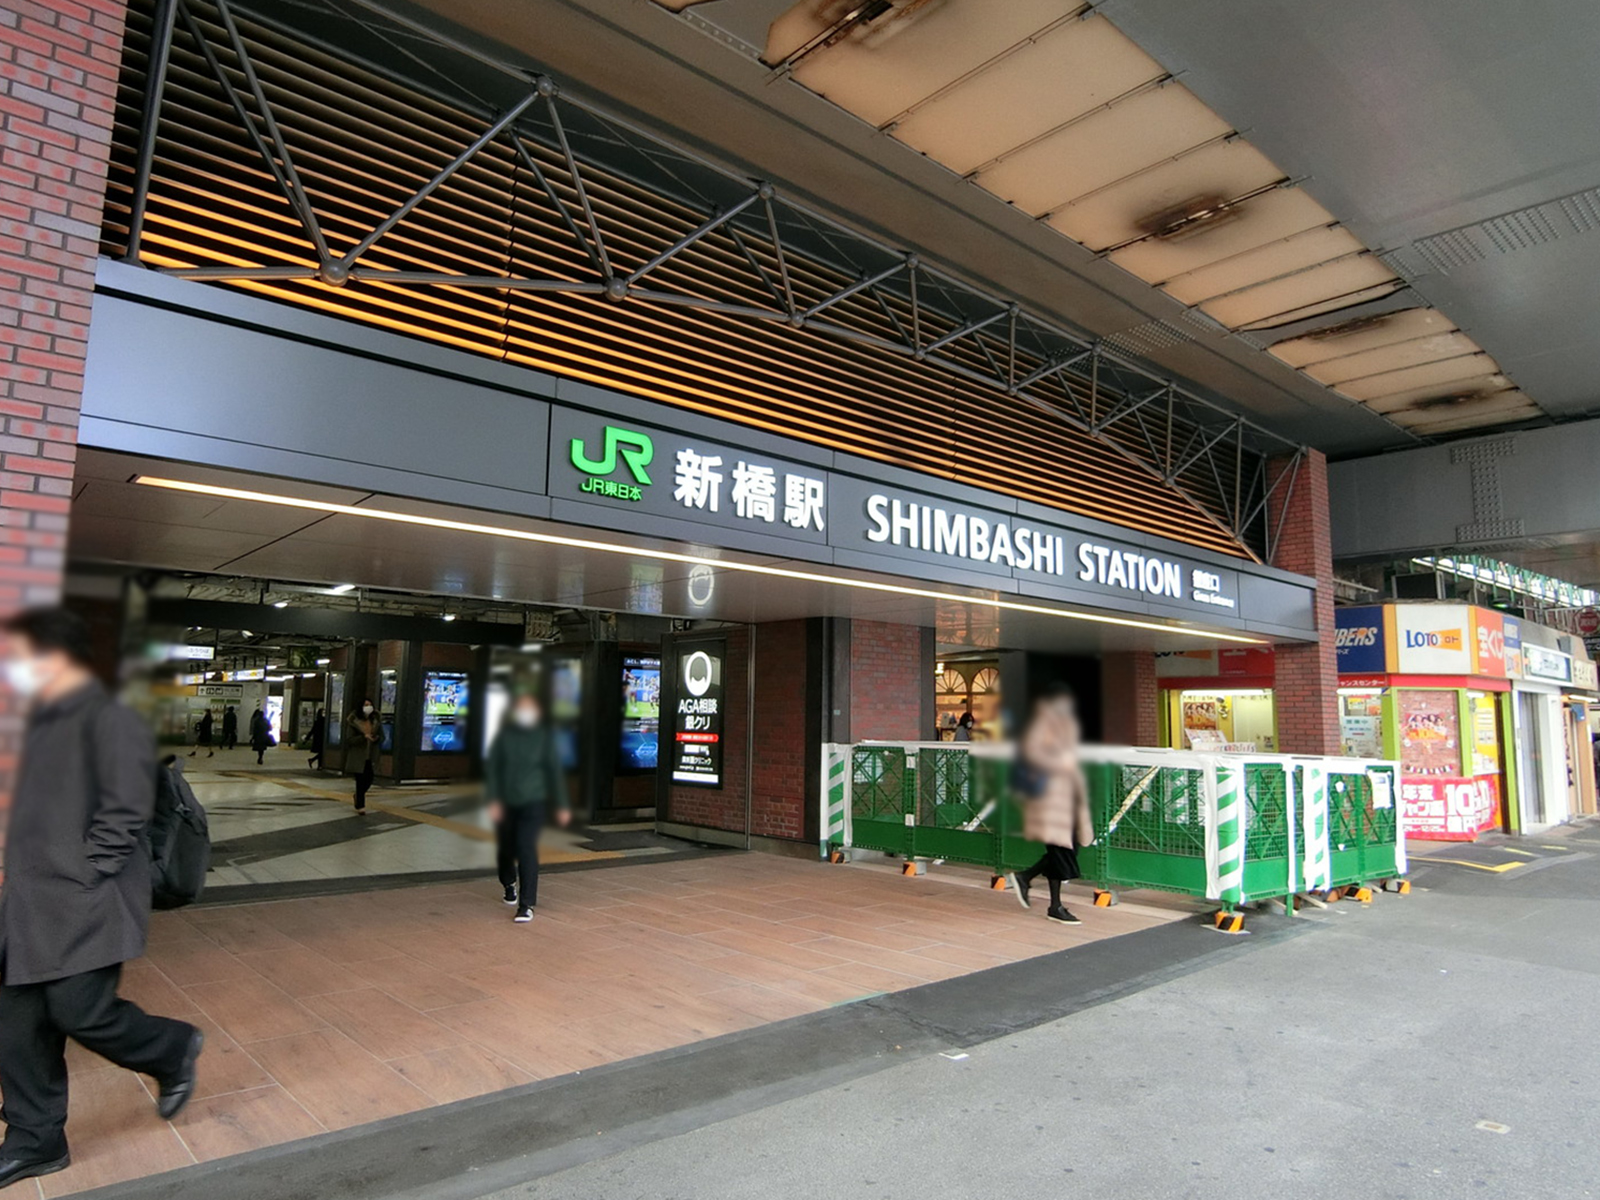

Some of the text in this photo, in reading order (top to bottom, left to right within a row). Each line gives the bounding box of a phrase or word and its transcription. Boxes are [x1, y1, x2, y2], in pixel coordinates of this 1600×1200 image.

[570, 425, 654, 485] JR
[579, 477, 642, 501] JR東日本
[673, 447, 825, 532] 新橋駅
[866, 494, 1182, 599] SHIMBASHI STATION
[1406, 629, 1438, 648] LOTO
[678, 698, 718, 714] AGA相談
